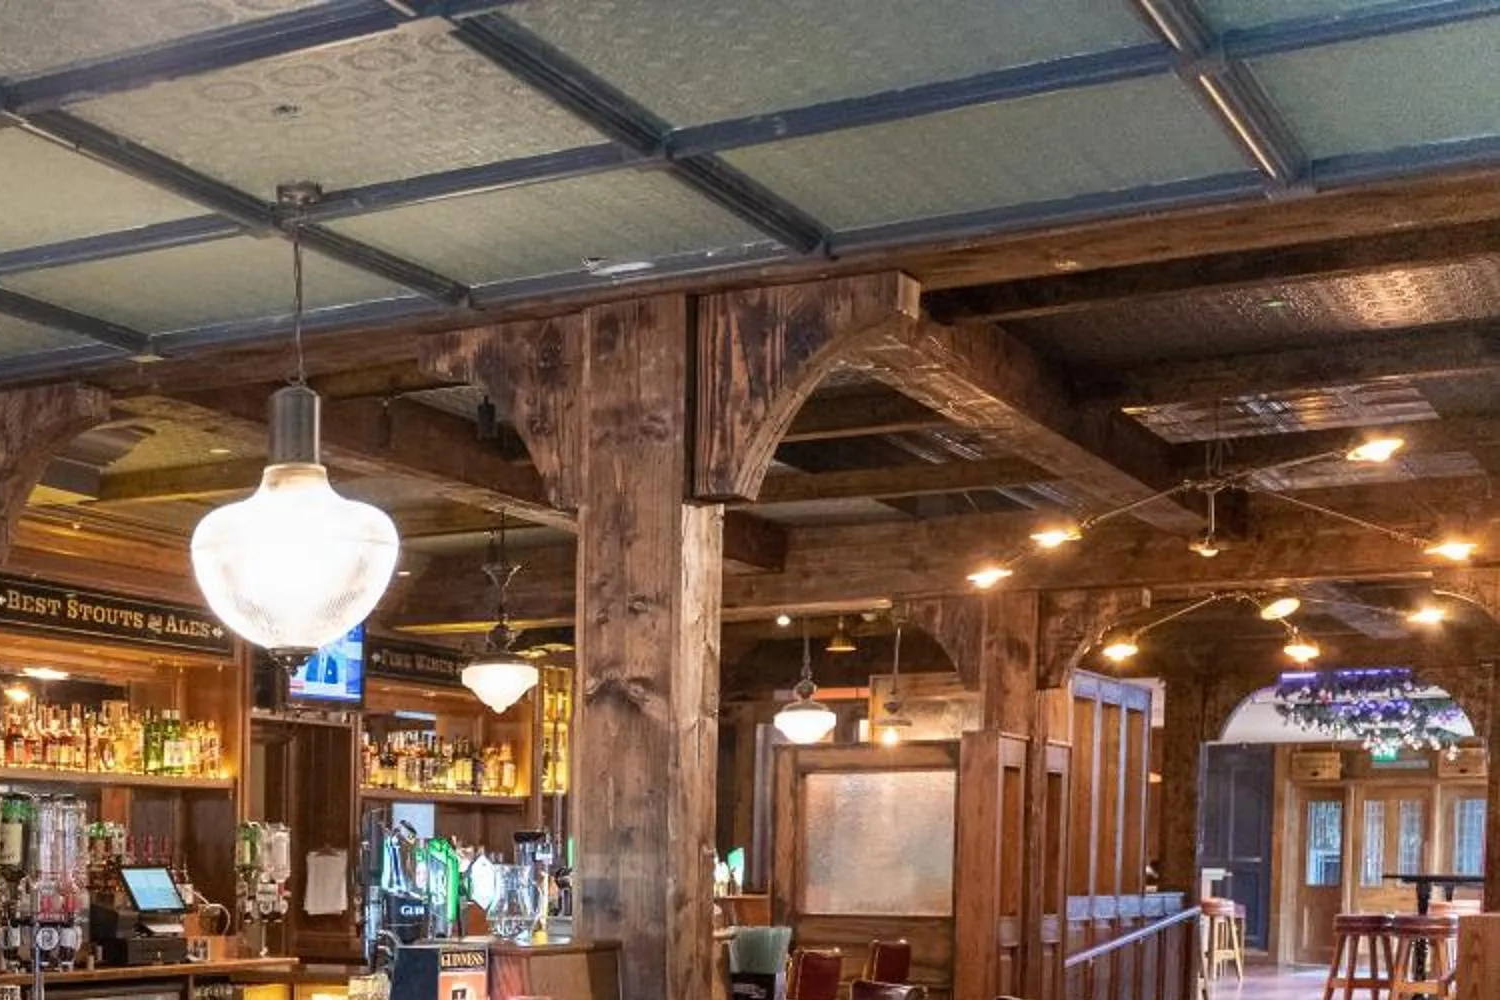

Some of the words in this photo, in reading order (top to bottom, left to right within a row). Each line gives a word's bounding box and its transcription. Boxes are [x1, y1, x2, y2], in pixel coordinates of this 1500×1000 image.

[7, 589, 61, 615] BEST
[66, 597, 144, 629] STOUTS
[165, 615, 211, 637] ALES
